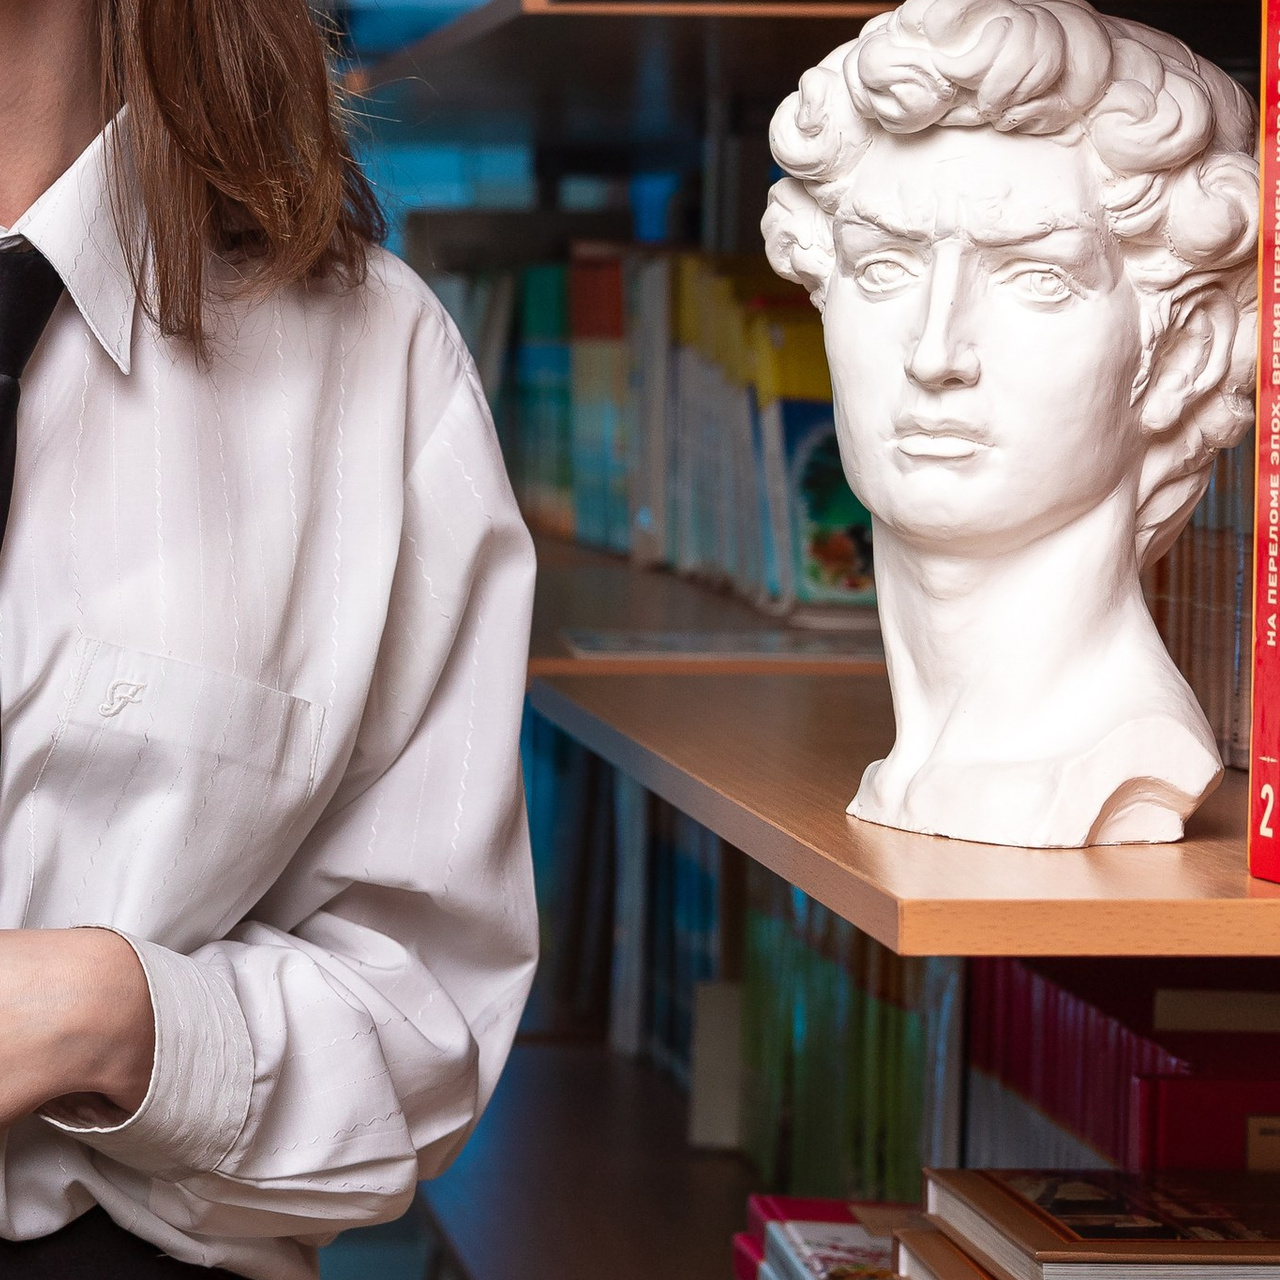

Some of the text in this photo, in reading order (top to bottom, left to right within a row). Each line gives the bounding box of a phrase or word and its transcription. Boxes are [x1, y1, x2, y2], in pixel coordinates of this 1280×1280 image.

[1272, 307, 1280, 385] ВРЕМЯ
[1267, 474, 1280, 604] ПЕРЕЛОМЕ
[1266, 613, 1277, 647] НА
[1259, 783, 1274, 838] 2
